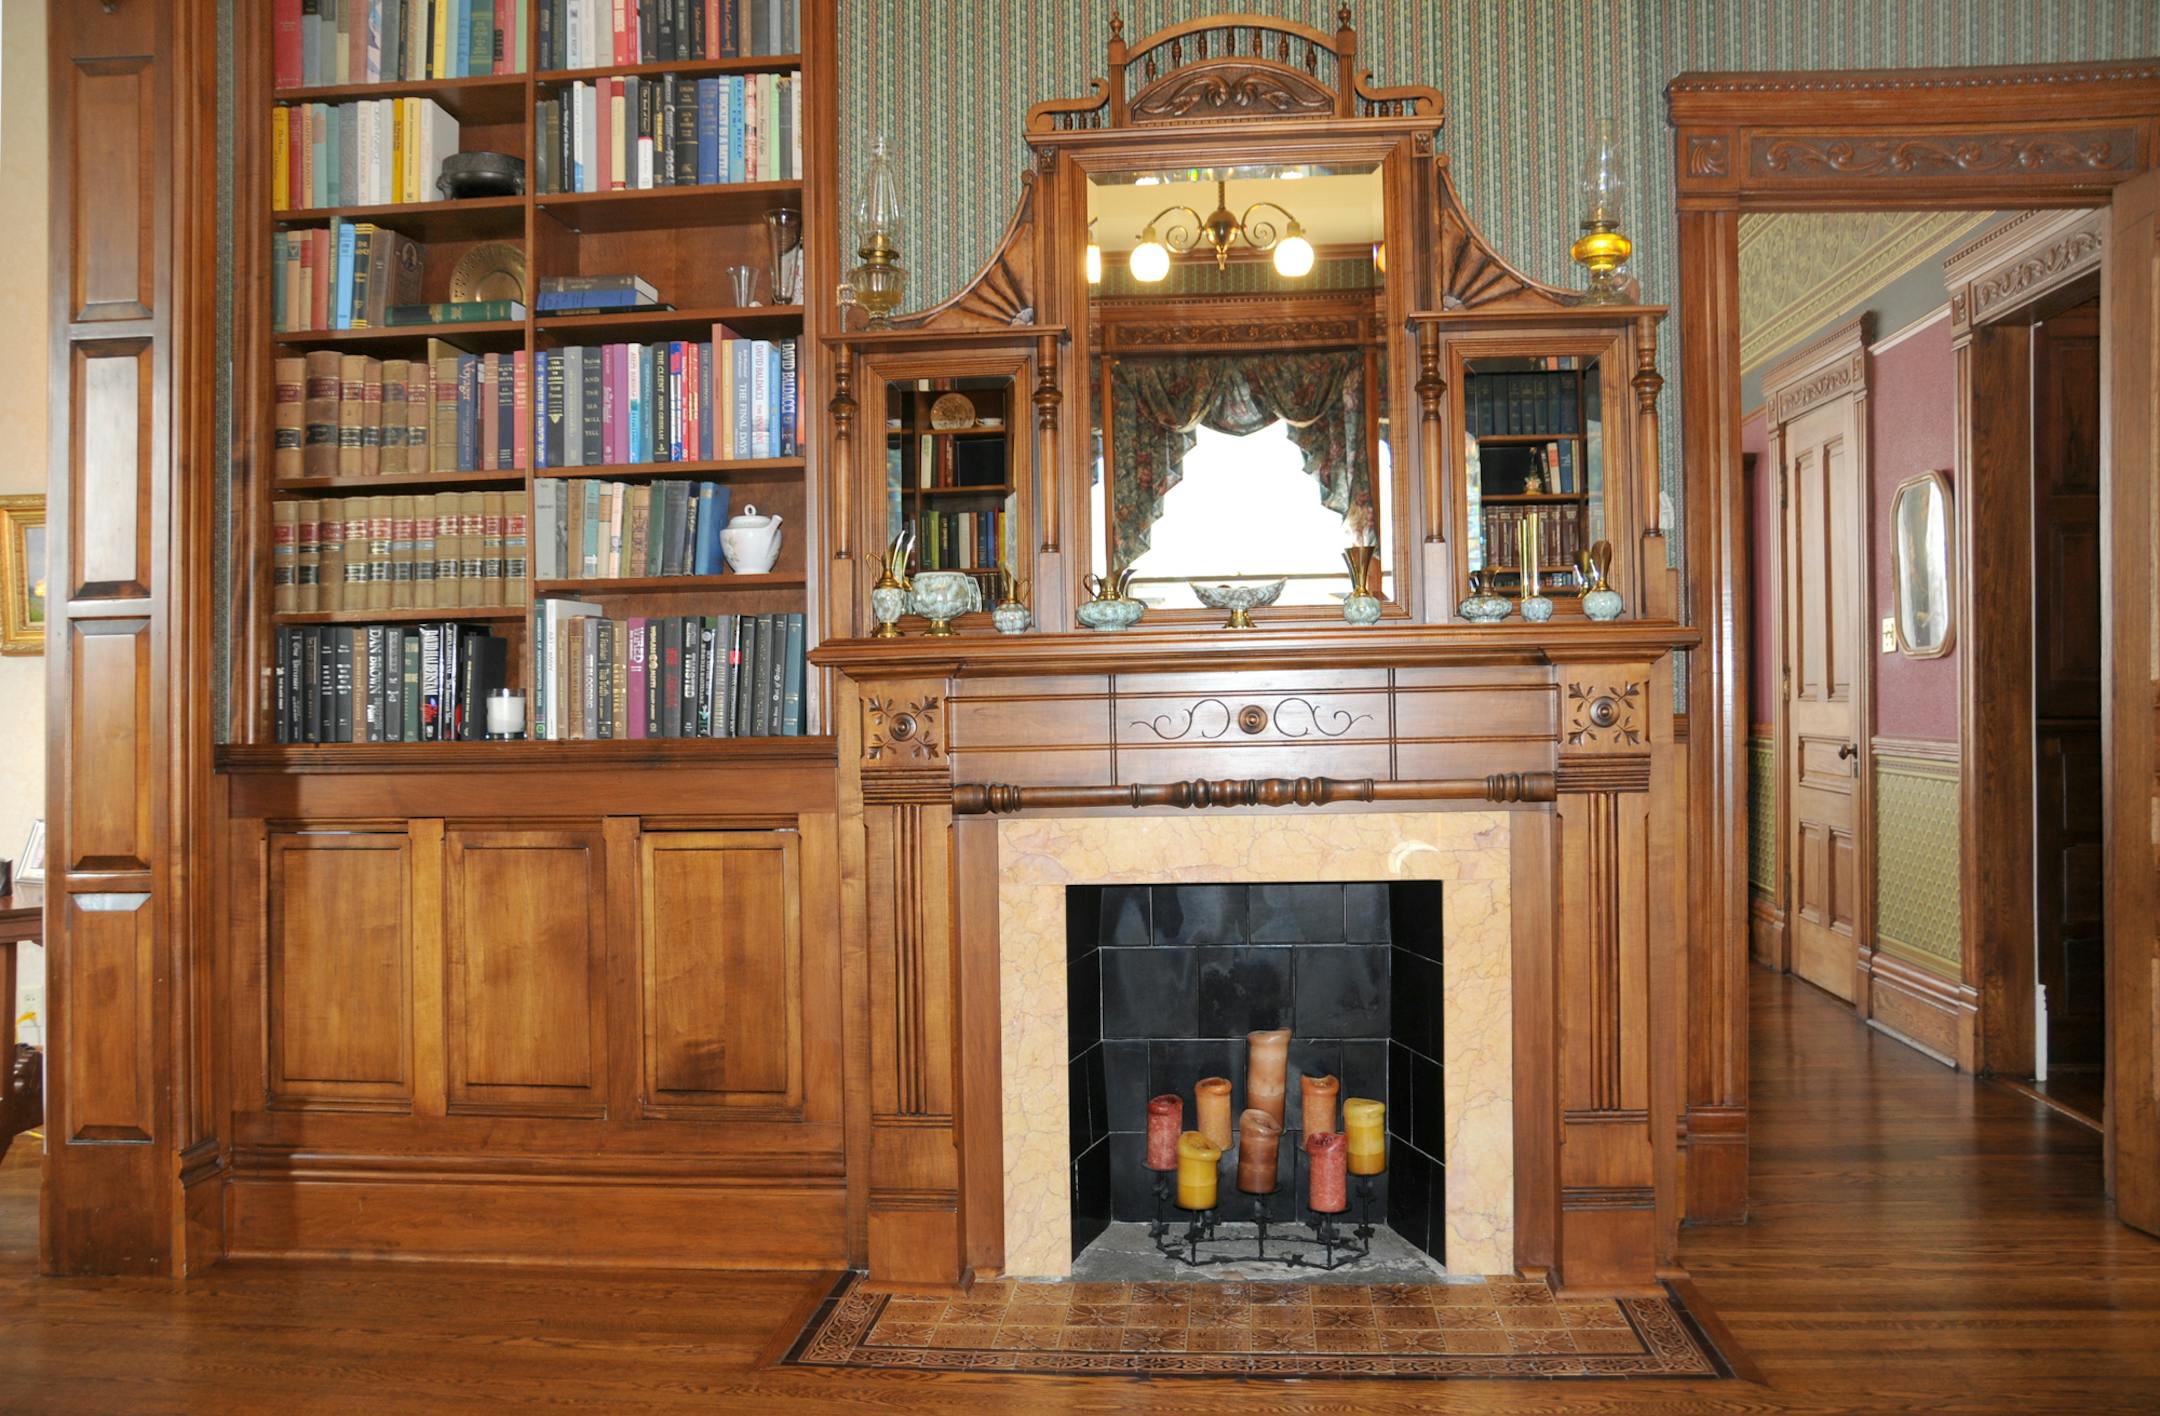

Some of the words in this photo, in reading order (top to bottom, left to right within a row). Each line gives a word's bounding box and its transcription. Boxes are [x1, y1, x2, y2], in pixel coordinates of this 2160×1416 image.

[755, 344, 764, 366] DAVID
[782, 343, 796, 369] DAVID
[459, 361, 475, 401] Voyager
[738, 383, 747, 401] THE
[755, 367, 764, 400] BALDACCI
[782, 371, 796, 413] BALDACCI
[738, 403, 747, 430] FINAL
[738, 432, 747, 454] DAYS
[369, 629, 382, 653] DAN
[633, 626, 644, 663] WIRED
[369, 656, 382, 694] BROWN
[423, 650, 439, 696] HALBERSTAM
[684, 652, 696, 698] TWISTED
